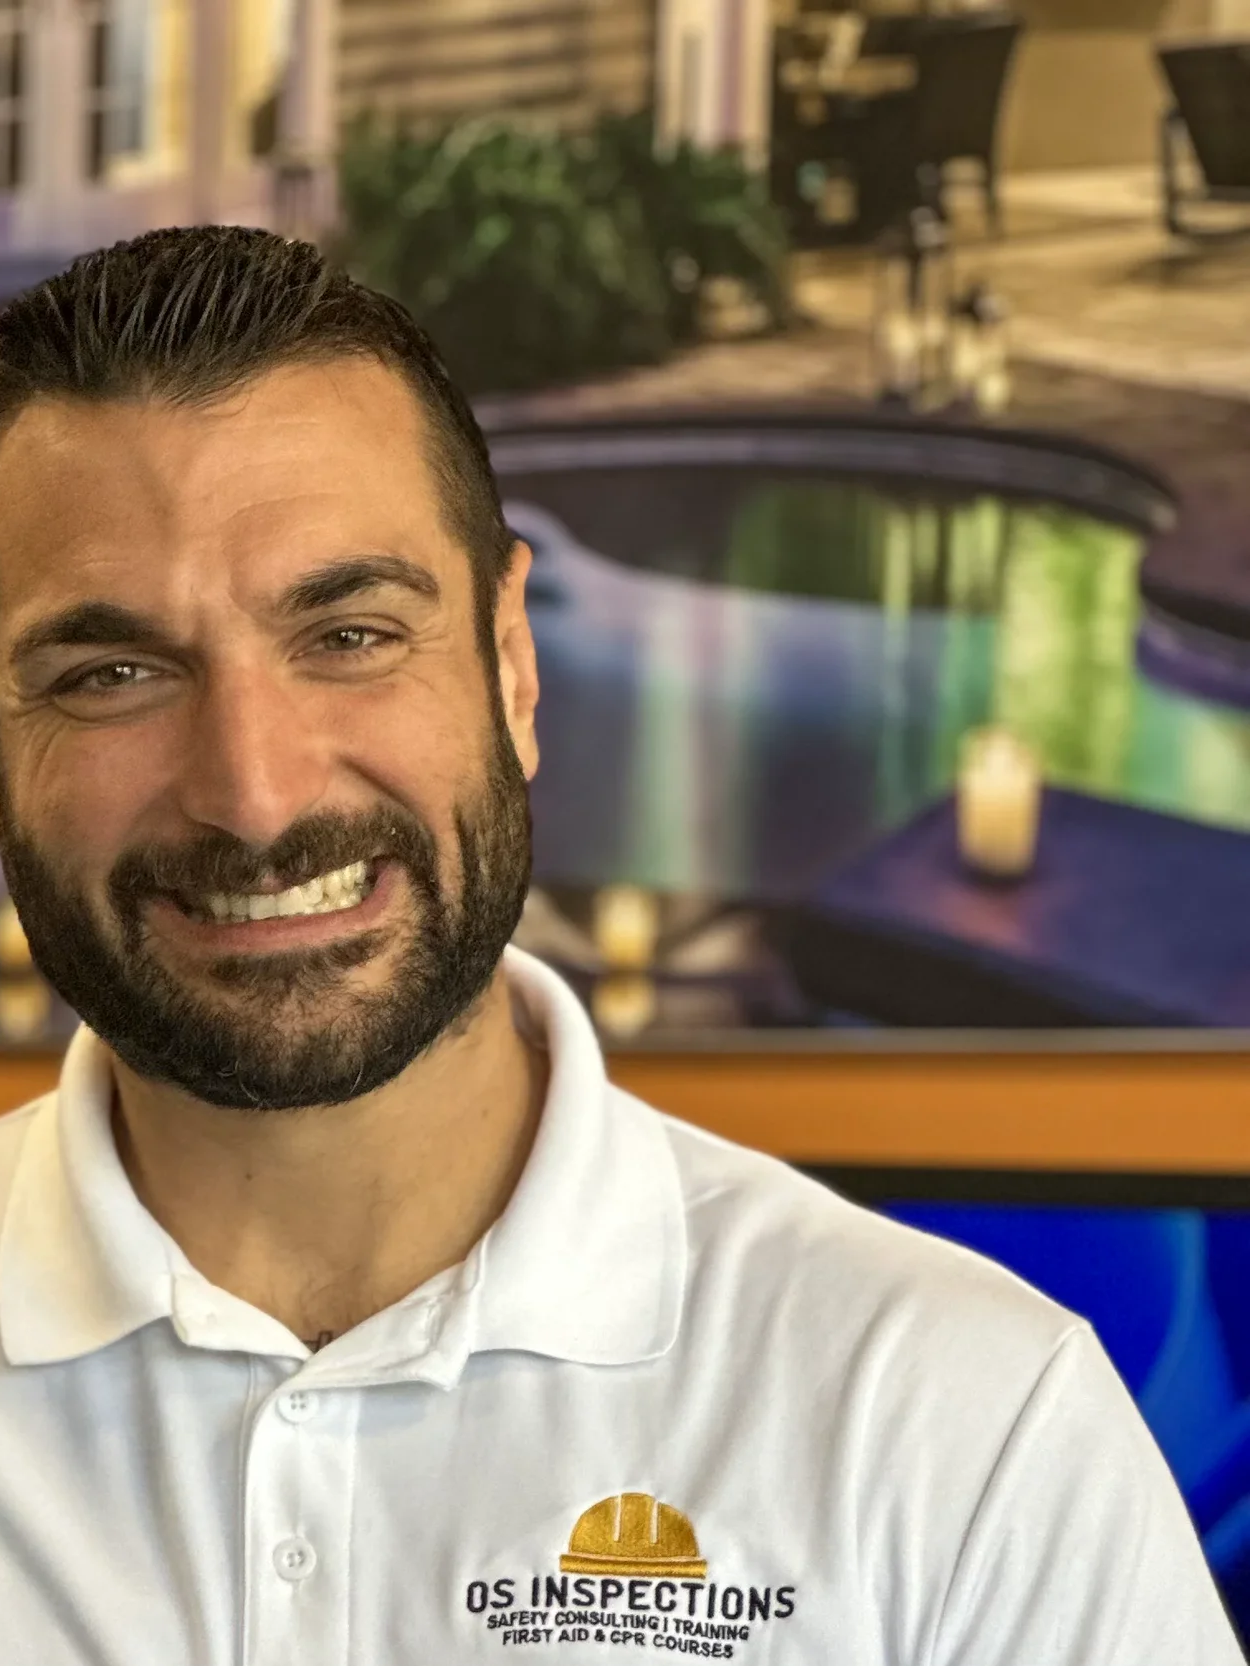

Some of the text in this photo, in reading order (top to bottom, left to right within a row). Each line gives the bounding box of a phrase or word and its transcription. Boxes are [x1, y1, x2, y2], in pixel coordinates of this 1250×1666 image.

[466, 1575, 796, 1621] OS INSPECTIONS
[487, 1611, 549, 1630] SAFETY
[554, 1610, 659, 1631] CONSULTING
[673, 1618, 750, 1641] TRAINING
[502, 1628, 734, 1660] FIRST AID & CPR COURSES
